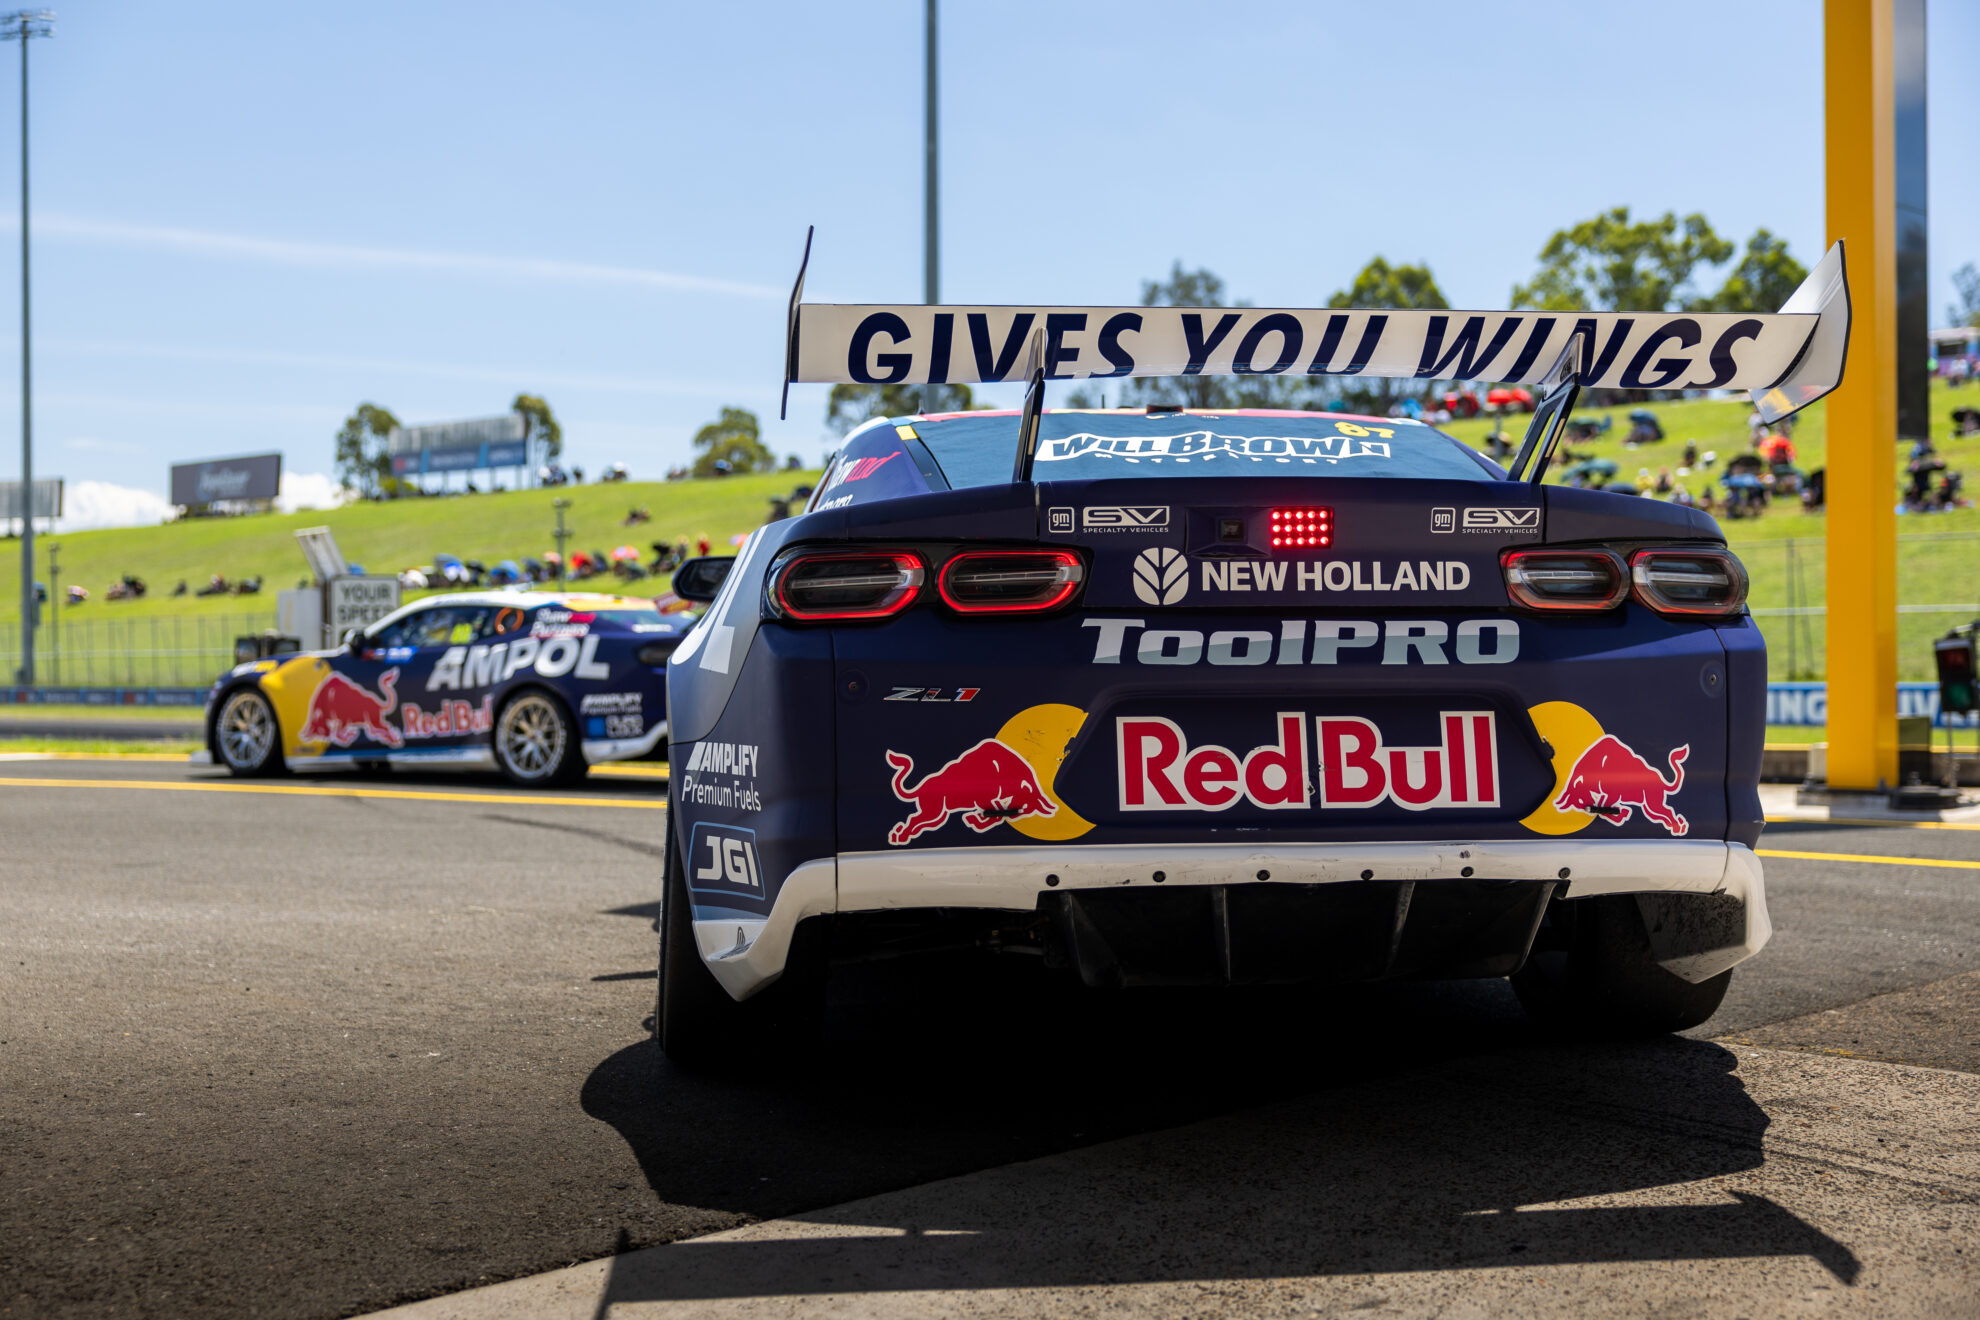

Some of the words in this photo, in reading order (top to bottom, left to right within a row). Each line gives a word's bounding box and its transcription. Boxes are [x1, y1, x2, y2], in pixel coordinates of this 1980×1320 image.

[848, 312, 1143, 384] GIVES
[1181, 313, 1389, 375] YOU
[1414, 316, 1764, 389] WINGS
[1334, 421, 1395, 438] 87
[1052, 513, 1070, 527] gm
[1083, 506, 1169, 526] SV
[1434, 513, 1451, 527] gm
[1463, 508, 1539, 527] SV
[340, 583, 392, 600] YOUR
[1202, 561, 1287, 592] NEW
[1298, 561, 1471, 592] HOLLAND
[338, 604, 393, 622] SPEE
[425, 633, 610, 692] AMPOL
[883, 687, 982, 702] ZL1
[1766, 690, 1828, 723] ING
[402, 702, 451, 738] Red
[697, 742, 759, 778] AMPLIFY
[1116, 712, 1311, 811] Red
[1316, 711, 1500, 811] Bull
[681, 775, 732, 808] Premium
[733, 780, 762, 813] Fuels
[697, 835, 759, 887] JGI
